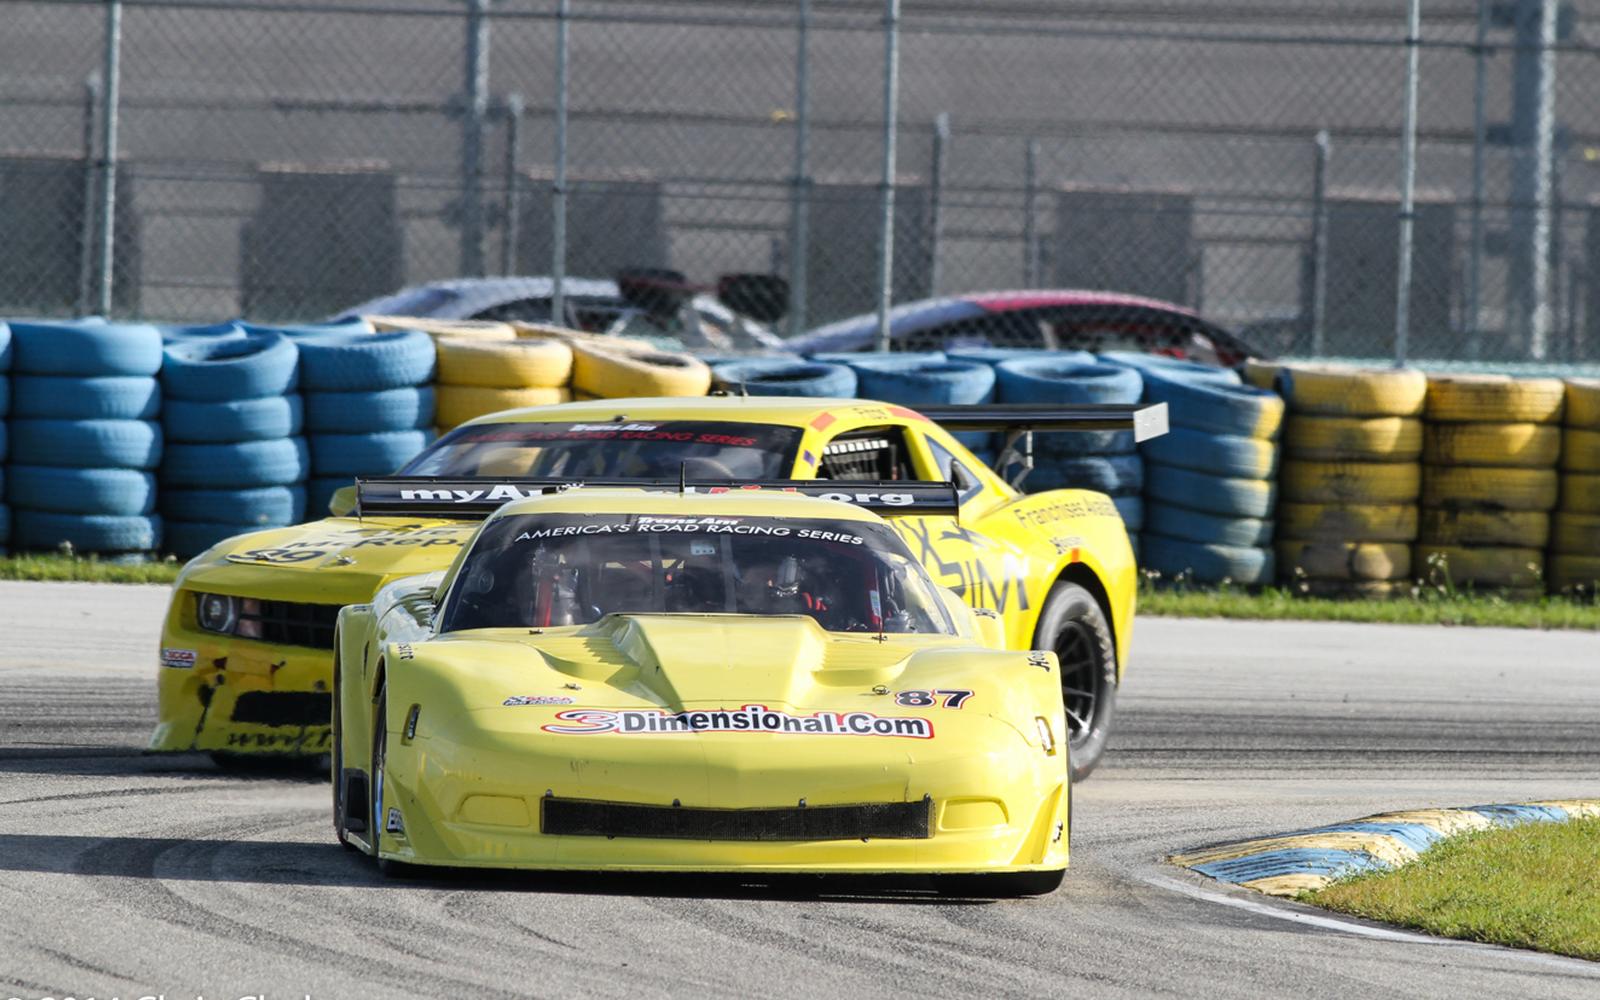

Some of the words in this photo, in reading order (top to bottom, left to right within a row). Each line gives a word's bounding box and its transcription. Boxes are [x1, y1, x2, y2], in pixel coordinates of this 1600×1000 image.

[620, 432, 694, 441] RACING
[696, 433, 757, 446] SERIES
[638, 516, 697, 525] Trans
[697, 517, 740, 526] Am
[514, 523, 631, 543] AMERICA'S
[637, 523, 700, 533] ROAD
[706, 525, 791, 537] RACING
[797, 528, 864, 545] SERIES
[895, 689, 973, 708] 87
[542, 705, 932, 737] 3Dimensional.Com
